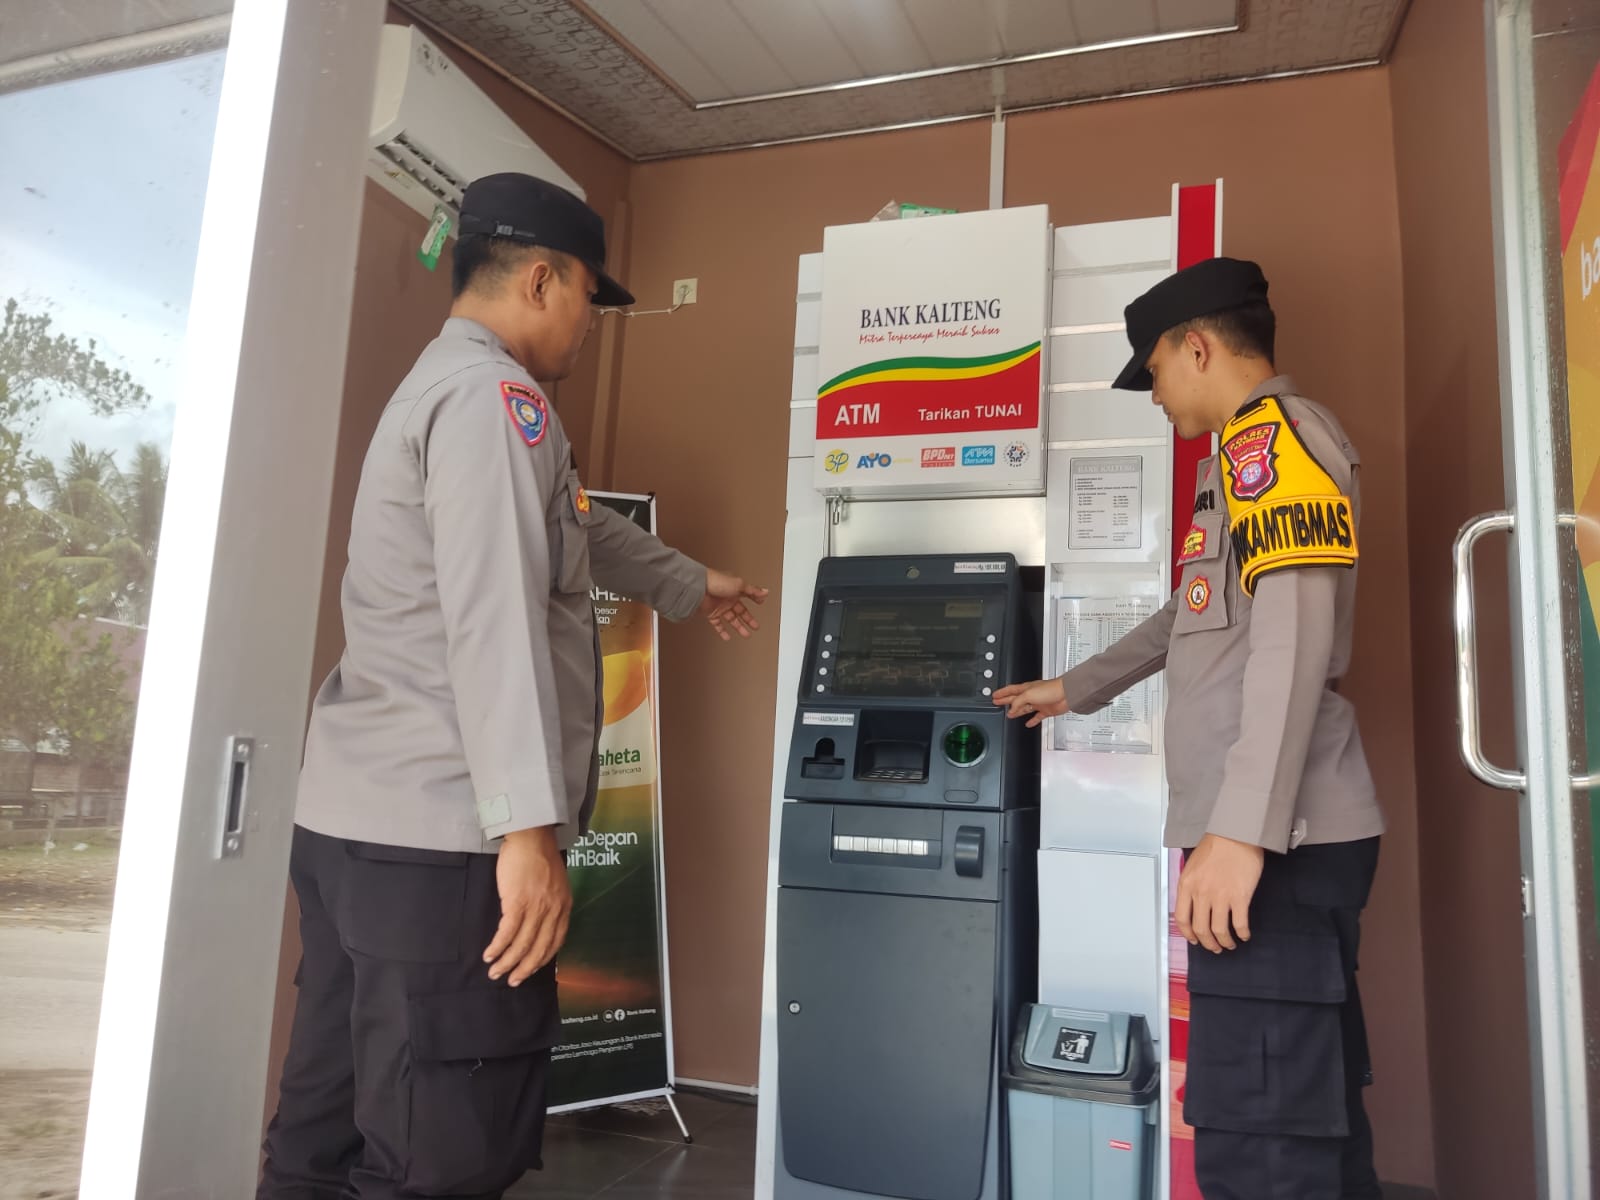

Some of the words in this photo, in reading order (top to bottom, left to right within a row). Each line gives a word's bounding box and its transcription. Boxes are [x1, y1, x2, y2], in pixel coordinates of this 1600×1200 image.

[860, 306, 910, 329] BANK
[915, 298, 1001, 325] KALTENG
[859, 333, 885, 344] Mitra
[971, 324, 1000, 337] Sukses
[834, 403, 880, 426] ATM
[918, 408, 970, 421] Tarikan
[975, 403, 1022, 418] TUNAI
[1229, 429, 1270, 450] POLRES
